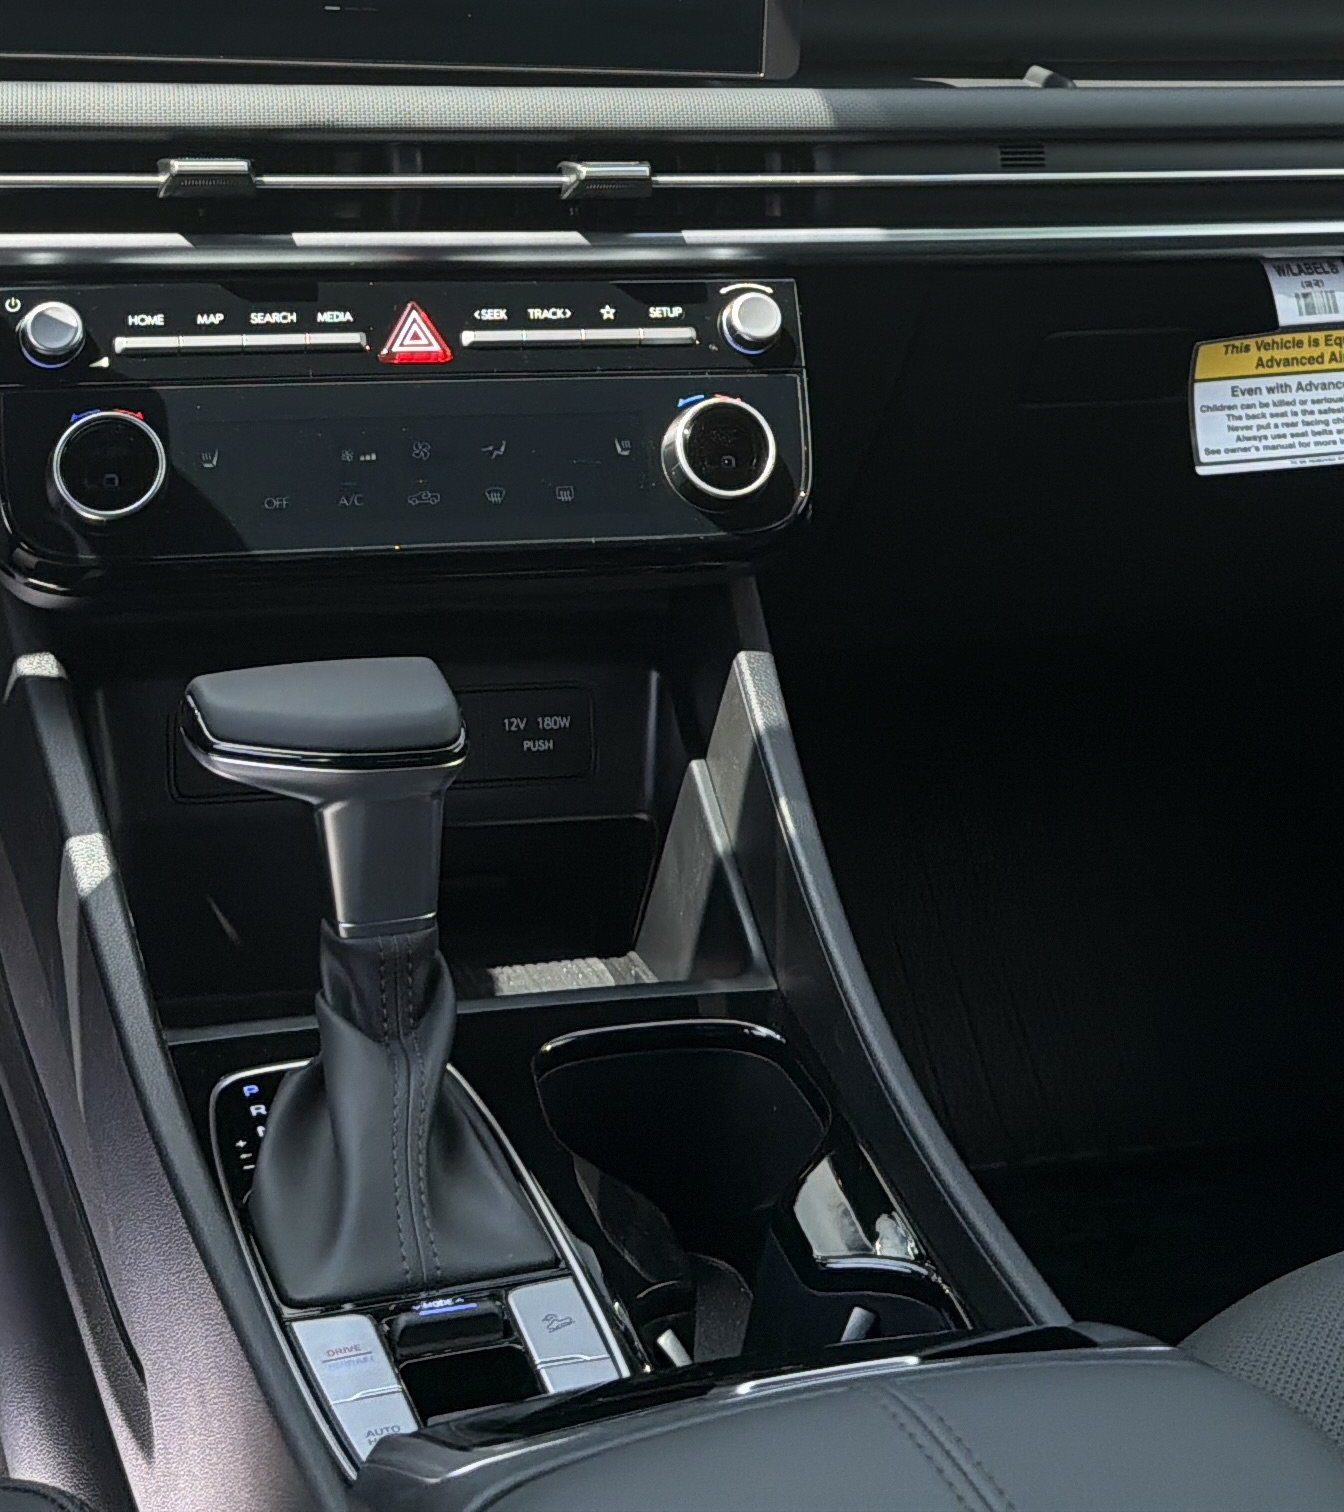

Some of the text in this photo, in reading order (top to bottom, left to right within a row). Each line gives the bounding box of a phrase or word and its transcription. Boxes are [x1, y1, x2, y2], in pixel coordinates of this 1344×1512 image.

[128, 314, 165, 326] HOME
[196, 313, 224, 324] MAP
[250, 311, 297, 324] SEARCH
[317, 311, 354, 323] MEDIA
[648, 307, 683, 319] SETUP
[1223, 342, 1251, 356] This
[1255, 336, 1304, 353] Vehicle
[1255, 352, 1325, 370] Advanced
[1230, 385, 1262, 398] Even
[1265, 382, 1293, 395] with
[1200, 404, 1238, 414] Children
[1240, 402, 1257, 410] can
[1272, 398, 1297, 408] killed
[1226, 413, 1243, 422] The
[1245, 412, 1267, 421] back
[1269, 410, 1288, 419] seat
[1300, 408, 1316, 416] the
[1317, 406, 1344, 416] safest
[1226, 424, 1254, 433] Never
[1256, 422, 1271, 432] put
[1281, 420, 1299, 429] rear
[1301, 418, 1330, 428] facing
[1235, 433, 1268, 443] Always
[1270, 432, 1287, 440] use
[1289, 430, 1309, 439] seat
[1311, 428, 1334, 437] belts
[1204, 447, 1222, 456] See
[1223, 445, 1260, 455] owner's
[1262, 441, 1296, 451] manual
[1298, 440, 1311, 448] for
[1313, 438, 1338, 447] more
[264, 494, 364, 510] OFF A/C
[503, 715, 571, 732] 12V 180W
[523, 739, 554, 752] PUSH
[242, 1084, 260, 1097] P
[249, 1104, 268, 1117] R
[326, 1343, 361, 1357] DRIVE
[365, 1424, 401, 1438] AUTO
